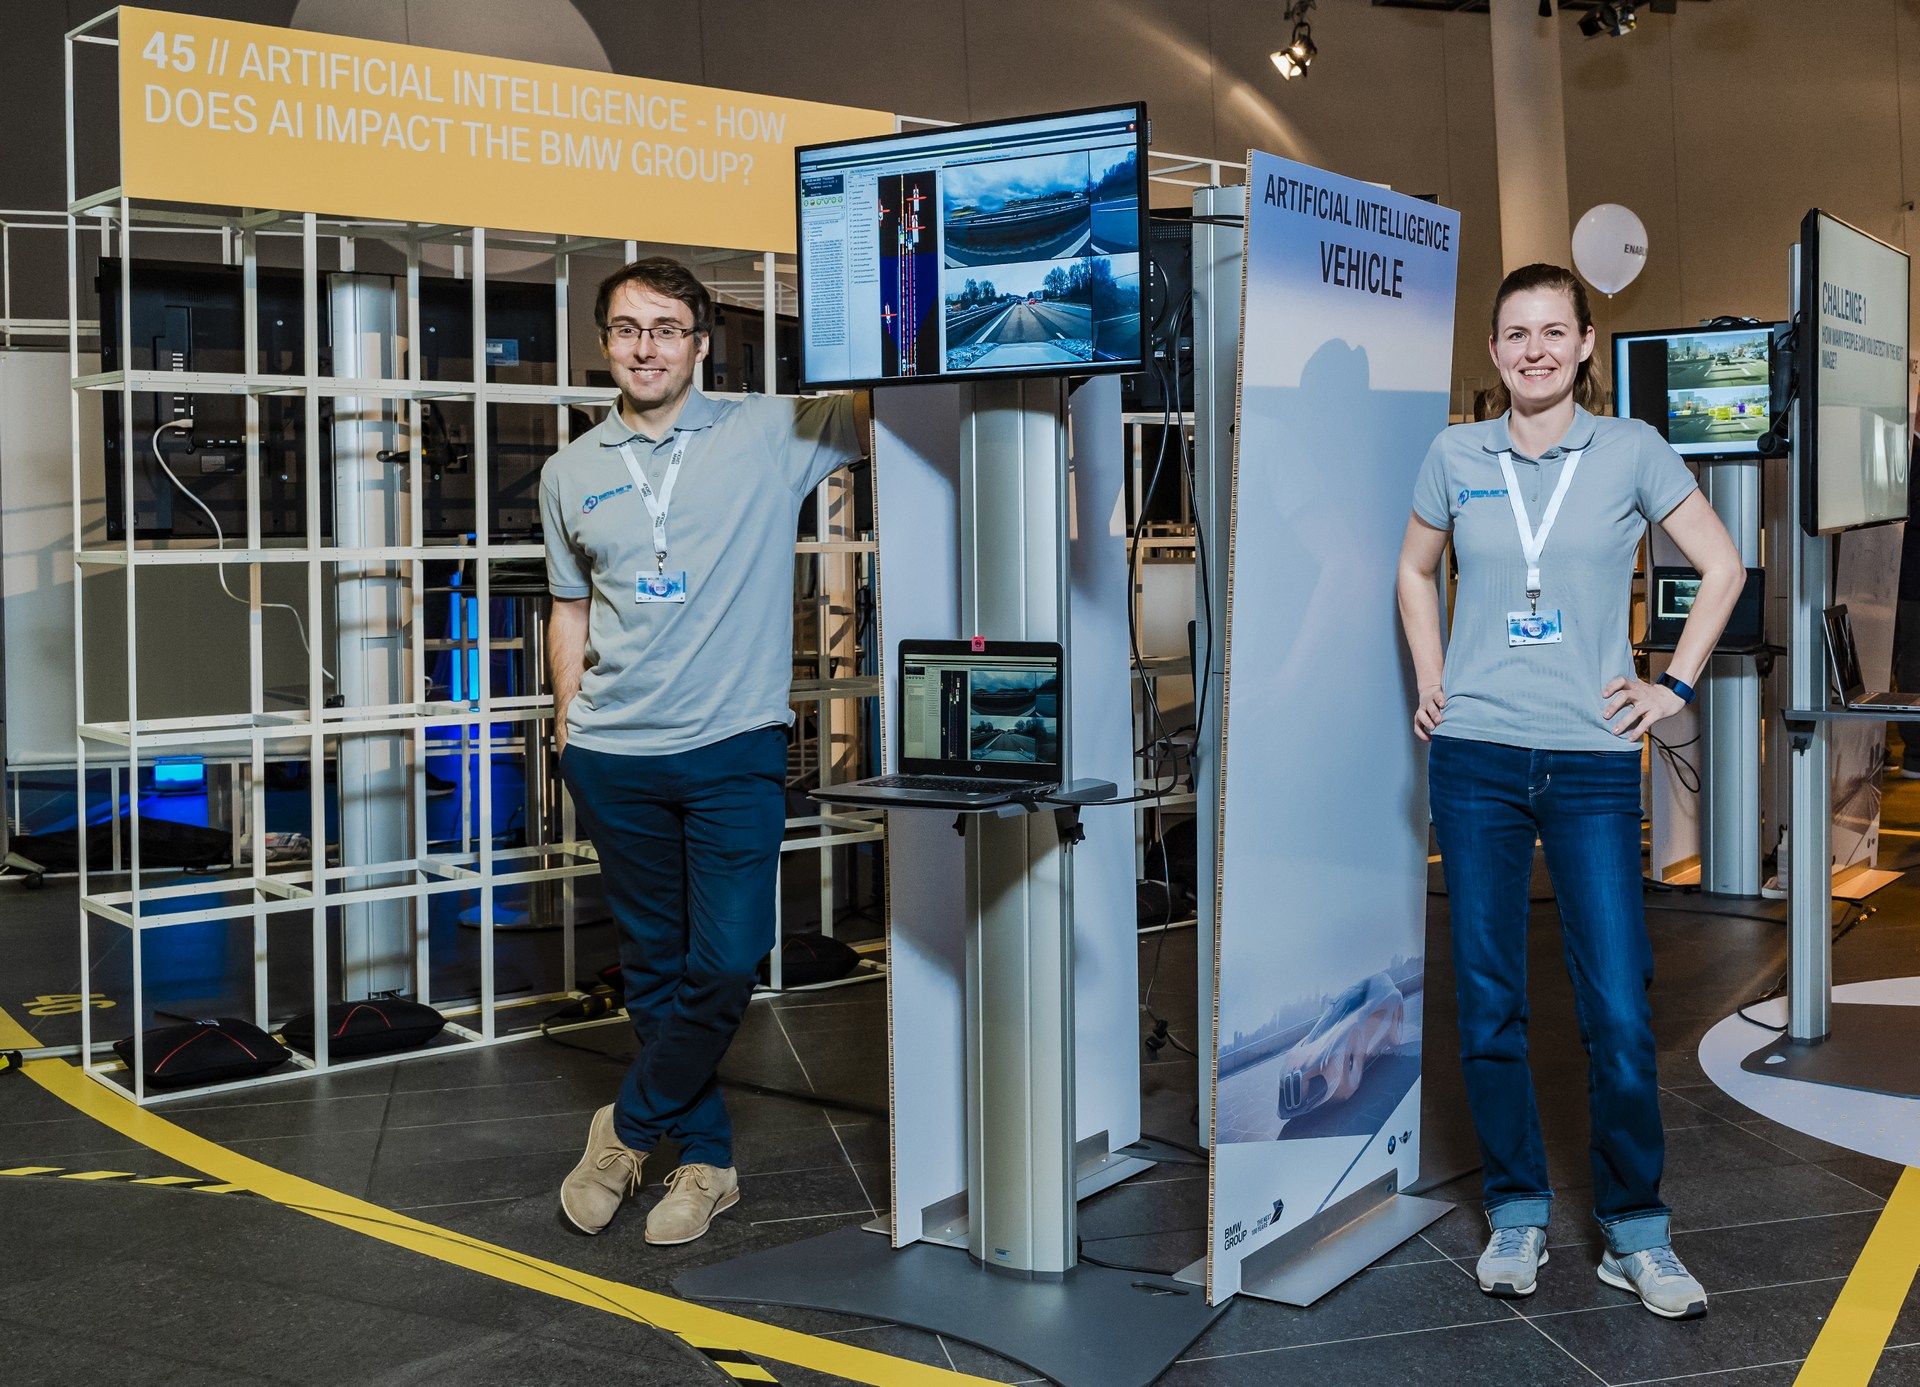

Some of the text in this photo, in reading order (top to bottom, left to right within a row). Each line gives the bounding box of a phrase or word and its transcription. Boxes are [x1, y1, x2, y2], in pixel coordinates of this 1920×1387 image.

[142, 31, 197, 73] 45
[239, 42, 444, 103] ARTIFICIAL
[453, 69, 689, 134] INTELLIGENCE
[715, 104, 786, 144] HOW
[145, 84, 258, 134] DOES
[268, 98, 303, 138] AI
[316, 103, 454, 154] IMPACT
[462, 121, 531, 163] THE
[541, 130, 622, 172] BMW
[631, 141, 754, 186] GROUP?
[1264, 173, 1451, 253] ARTIFICIAL INTELLIGENCE
[1320, 240, 1404, 299] VEHICLE
[1822, 281, 1862, 325] CHALLENGE
[1225, 1221, 1242, 1239] BMW
[1225, 1230, 1247, 1250] GROUP
